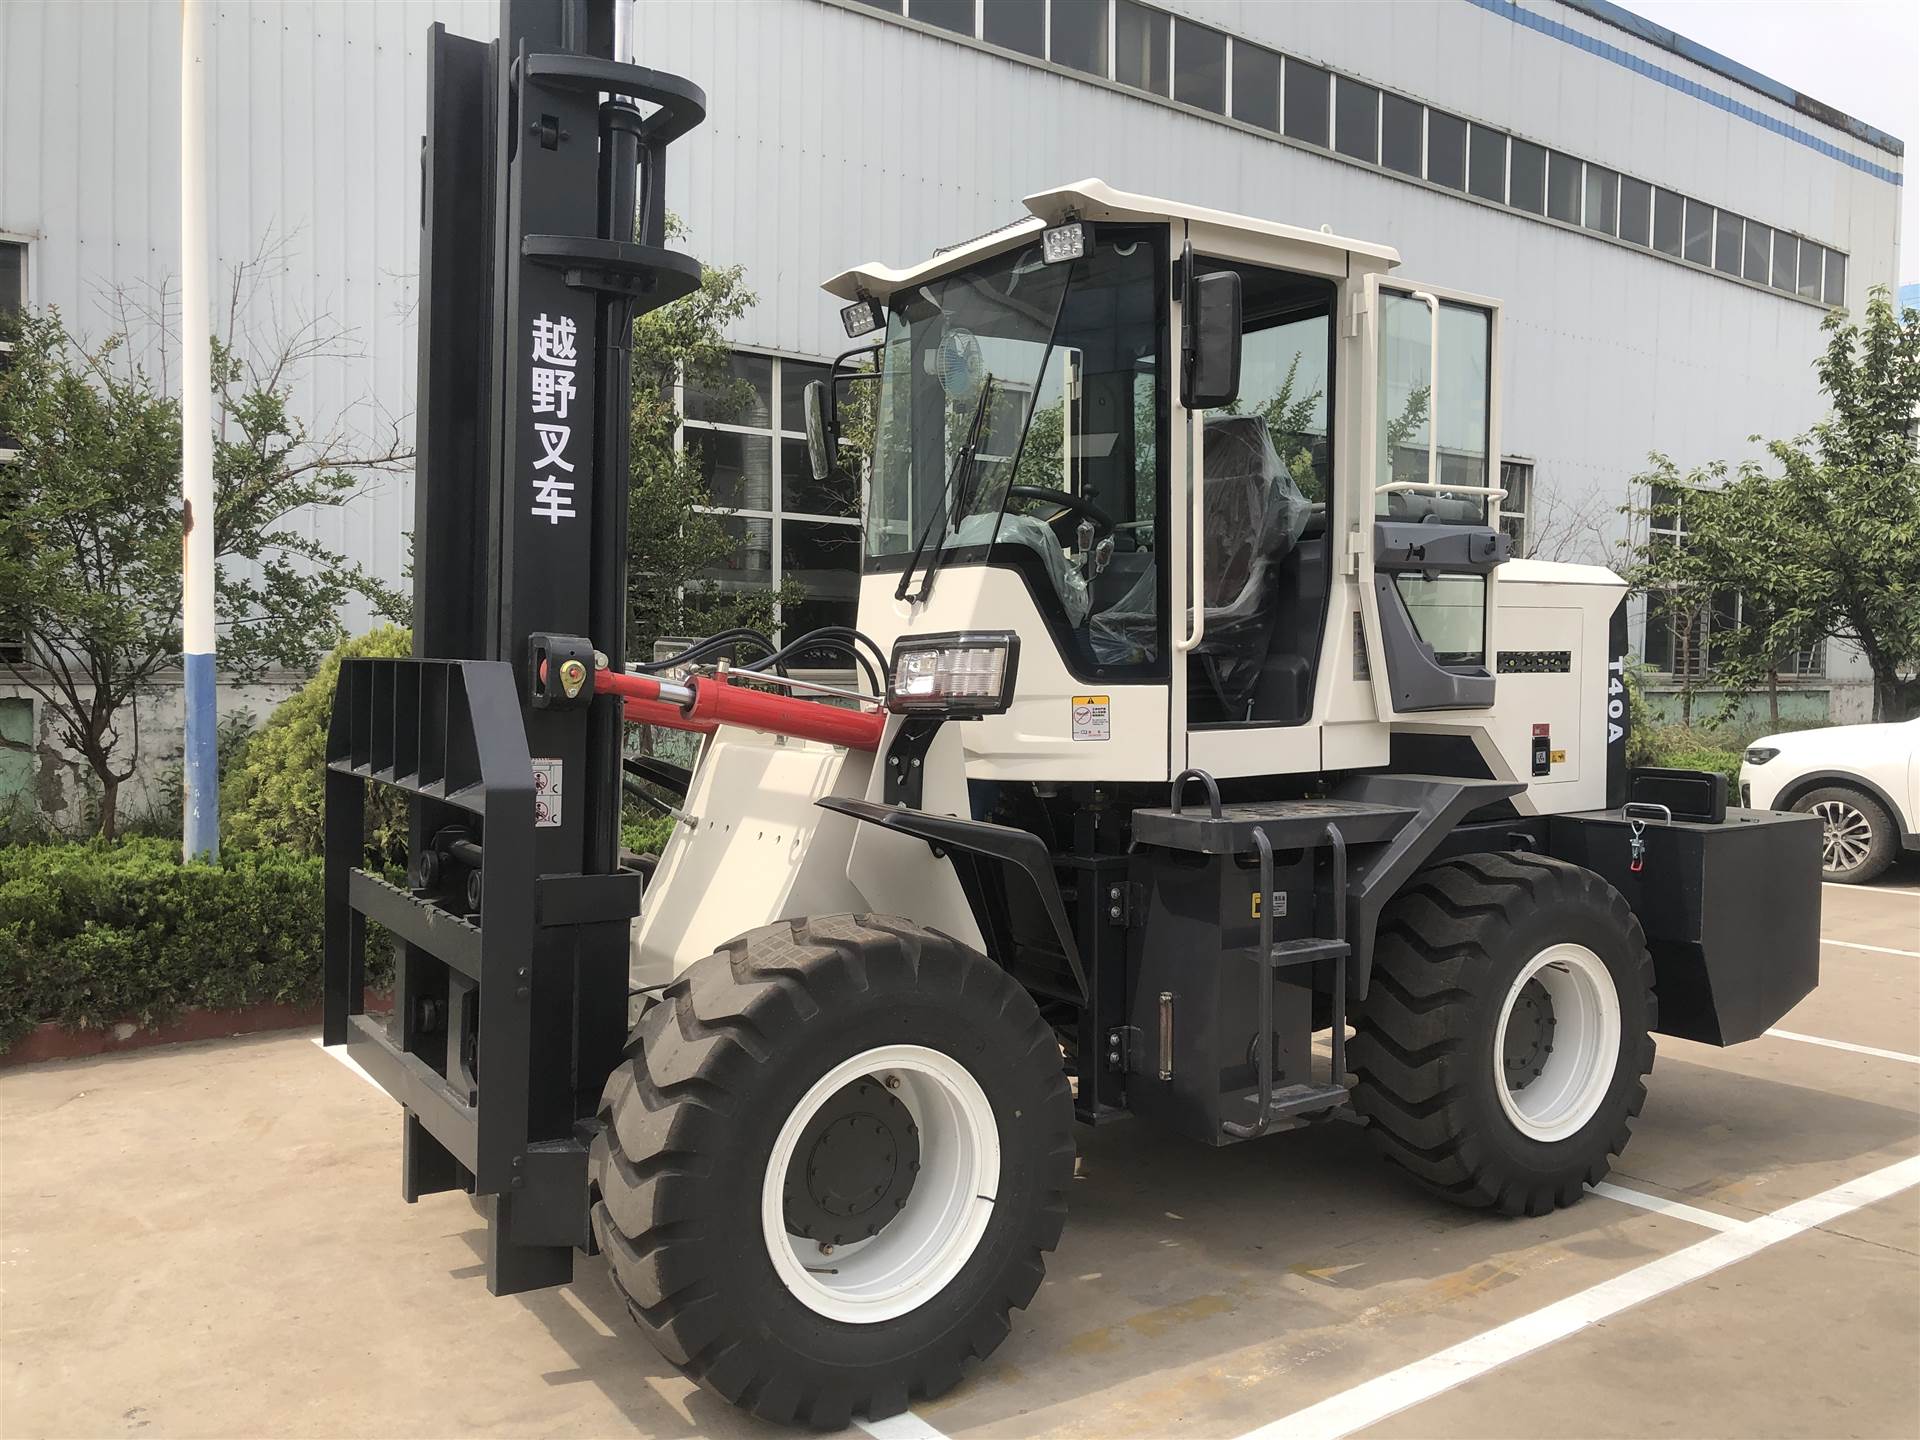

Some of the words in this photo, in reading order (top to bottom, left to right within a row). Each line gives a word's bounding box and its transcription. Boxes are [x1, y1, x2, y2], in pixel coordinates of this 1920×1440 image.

[531, 313, 577, 525] 越野叉车
[1608, 655, 1624, 744] T40A
